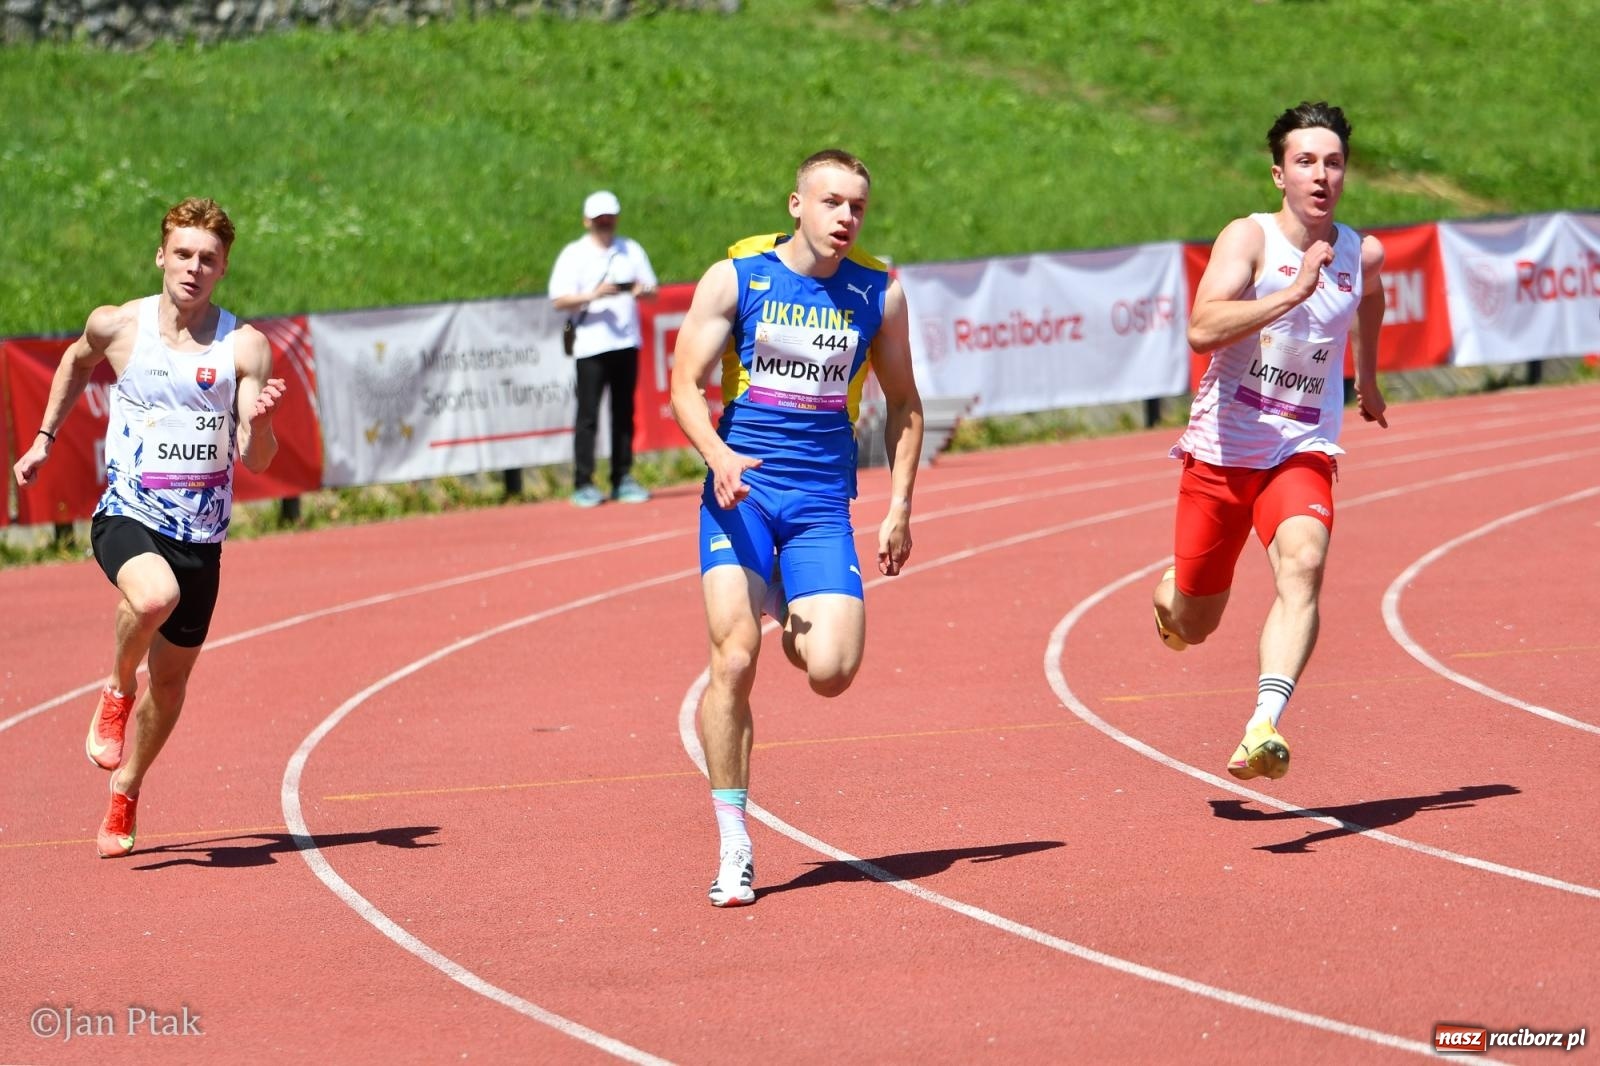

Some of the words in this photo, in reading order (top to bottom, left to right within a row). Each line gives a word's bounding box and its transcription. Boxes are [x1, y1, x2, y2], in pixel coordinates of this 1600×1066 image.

[762, 300, 855, 331] UKRAINE
[812, 334, 848, 351] 444
[954, 307, 1085, 352] Racibórz
[755, 356, 848, 383] MUDRYK
[1312, 348, 1329, 364] 44
[1249, 359, 1325, 395] LATKOWSKI
[501, 378, 577, 408] Turysty
[195, 416, 224, 430] 347
[158, 443, 217, 460] SAUER
